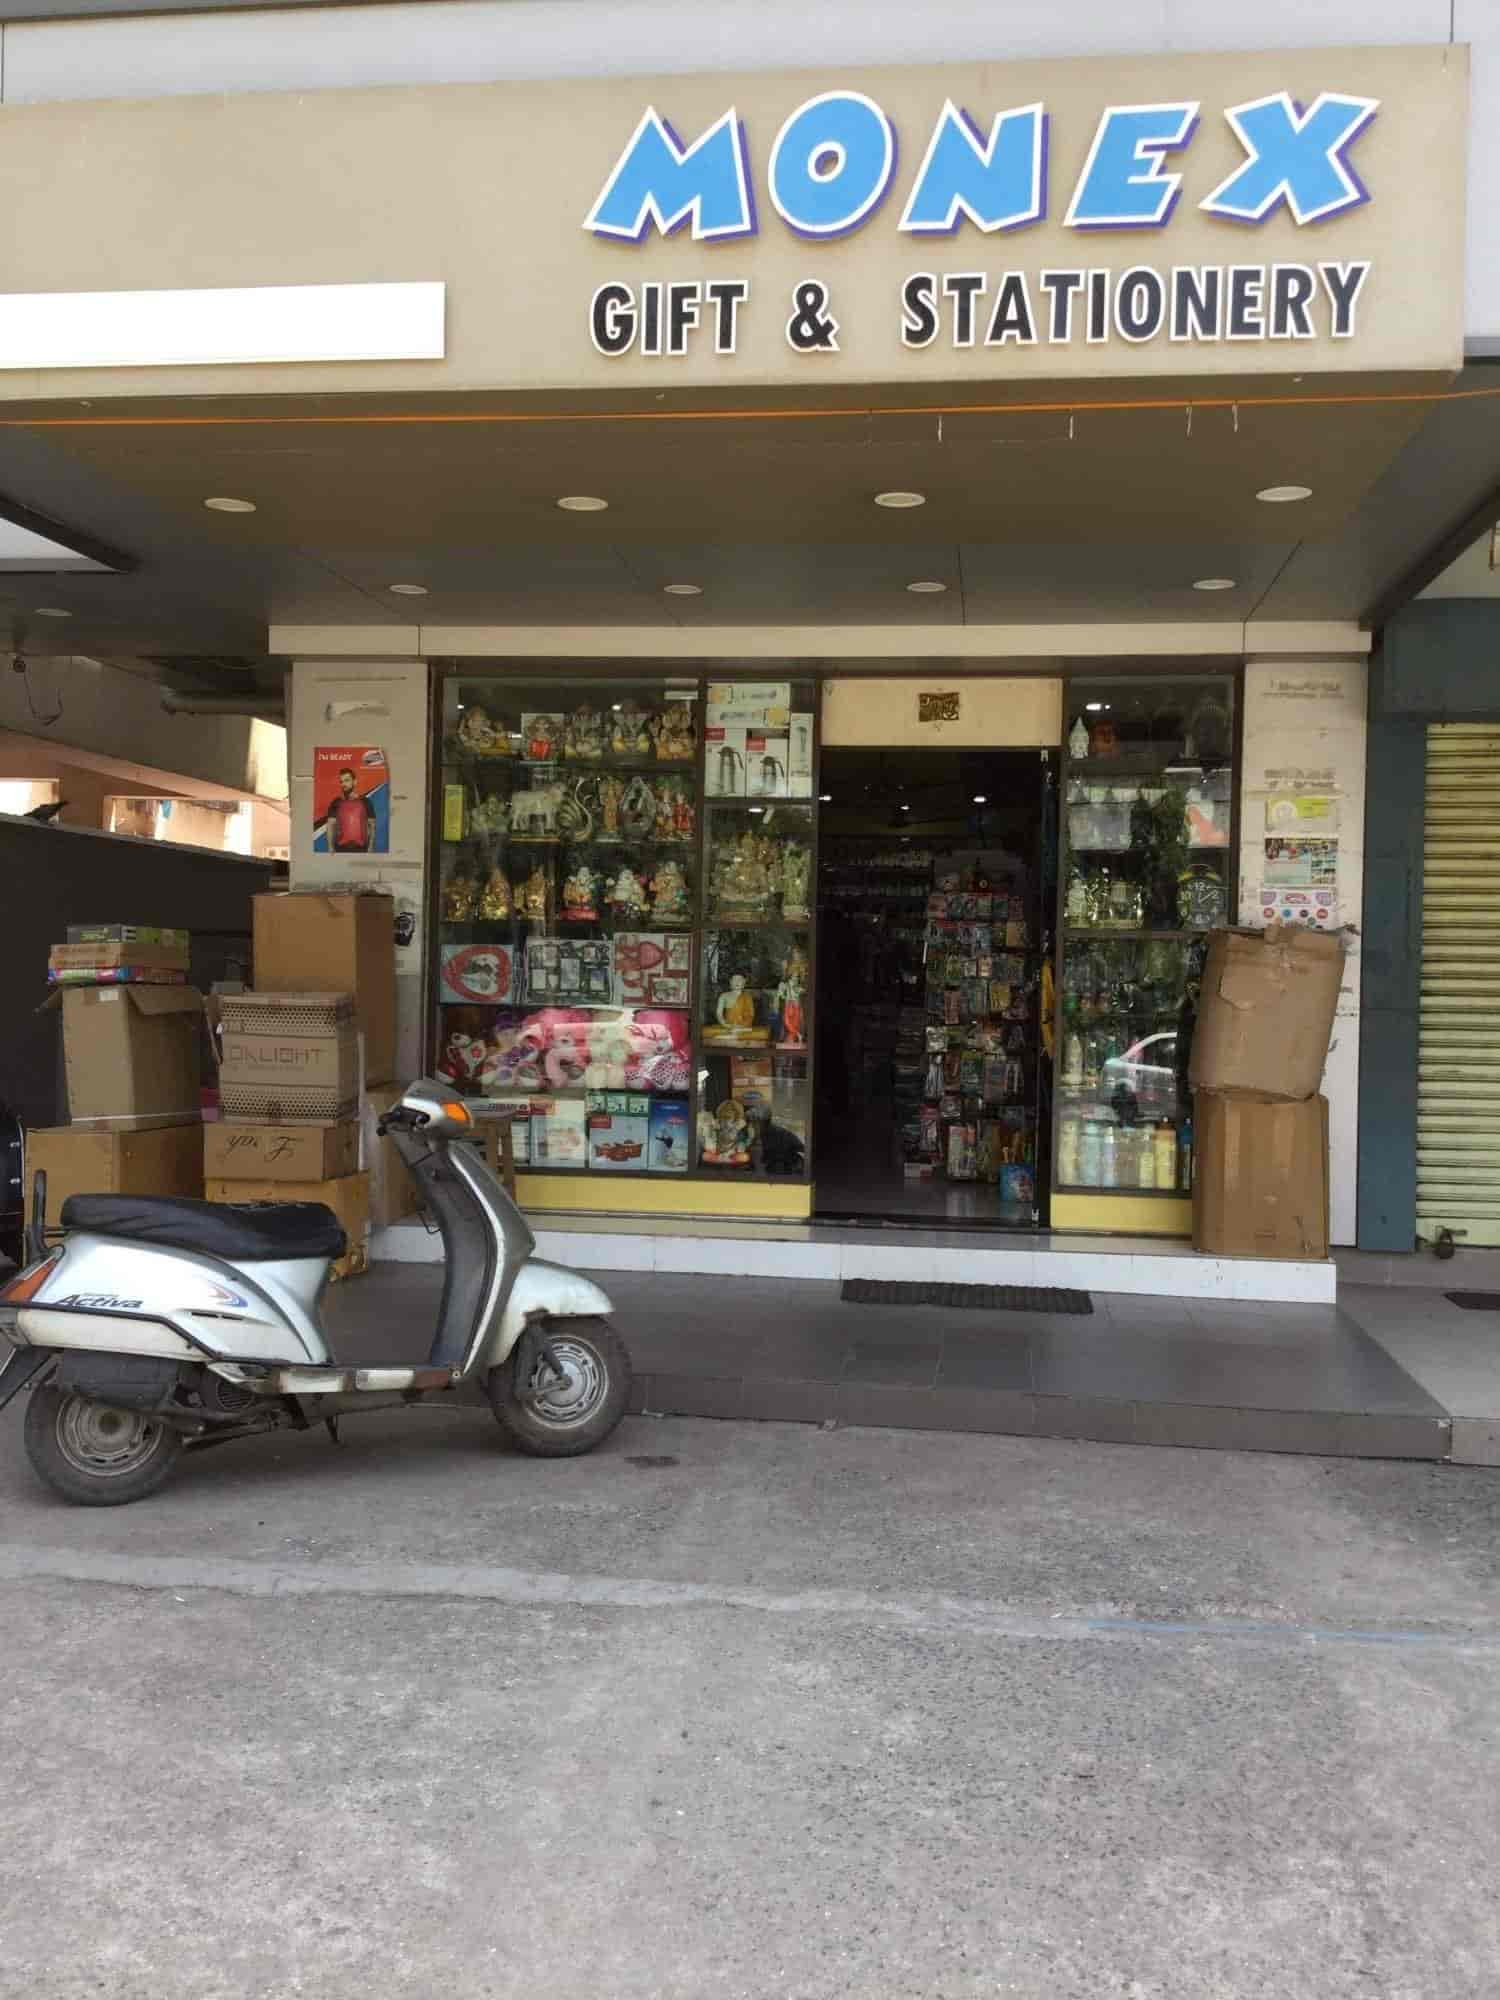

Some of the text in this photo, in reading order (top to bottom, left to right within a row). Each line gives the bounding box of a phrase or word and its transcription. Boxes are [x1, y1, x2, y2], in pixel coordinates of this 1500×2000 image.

[582, 89, 1380, 242] MONEX
[591, 260, 1373, 355] GIFT & STATIONERY
[55, 1294, 143, 1308] Activa
